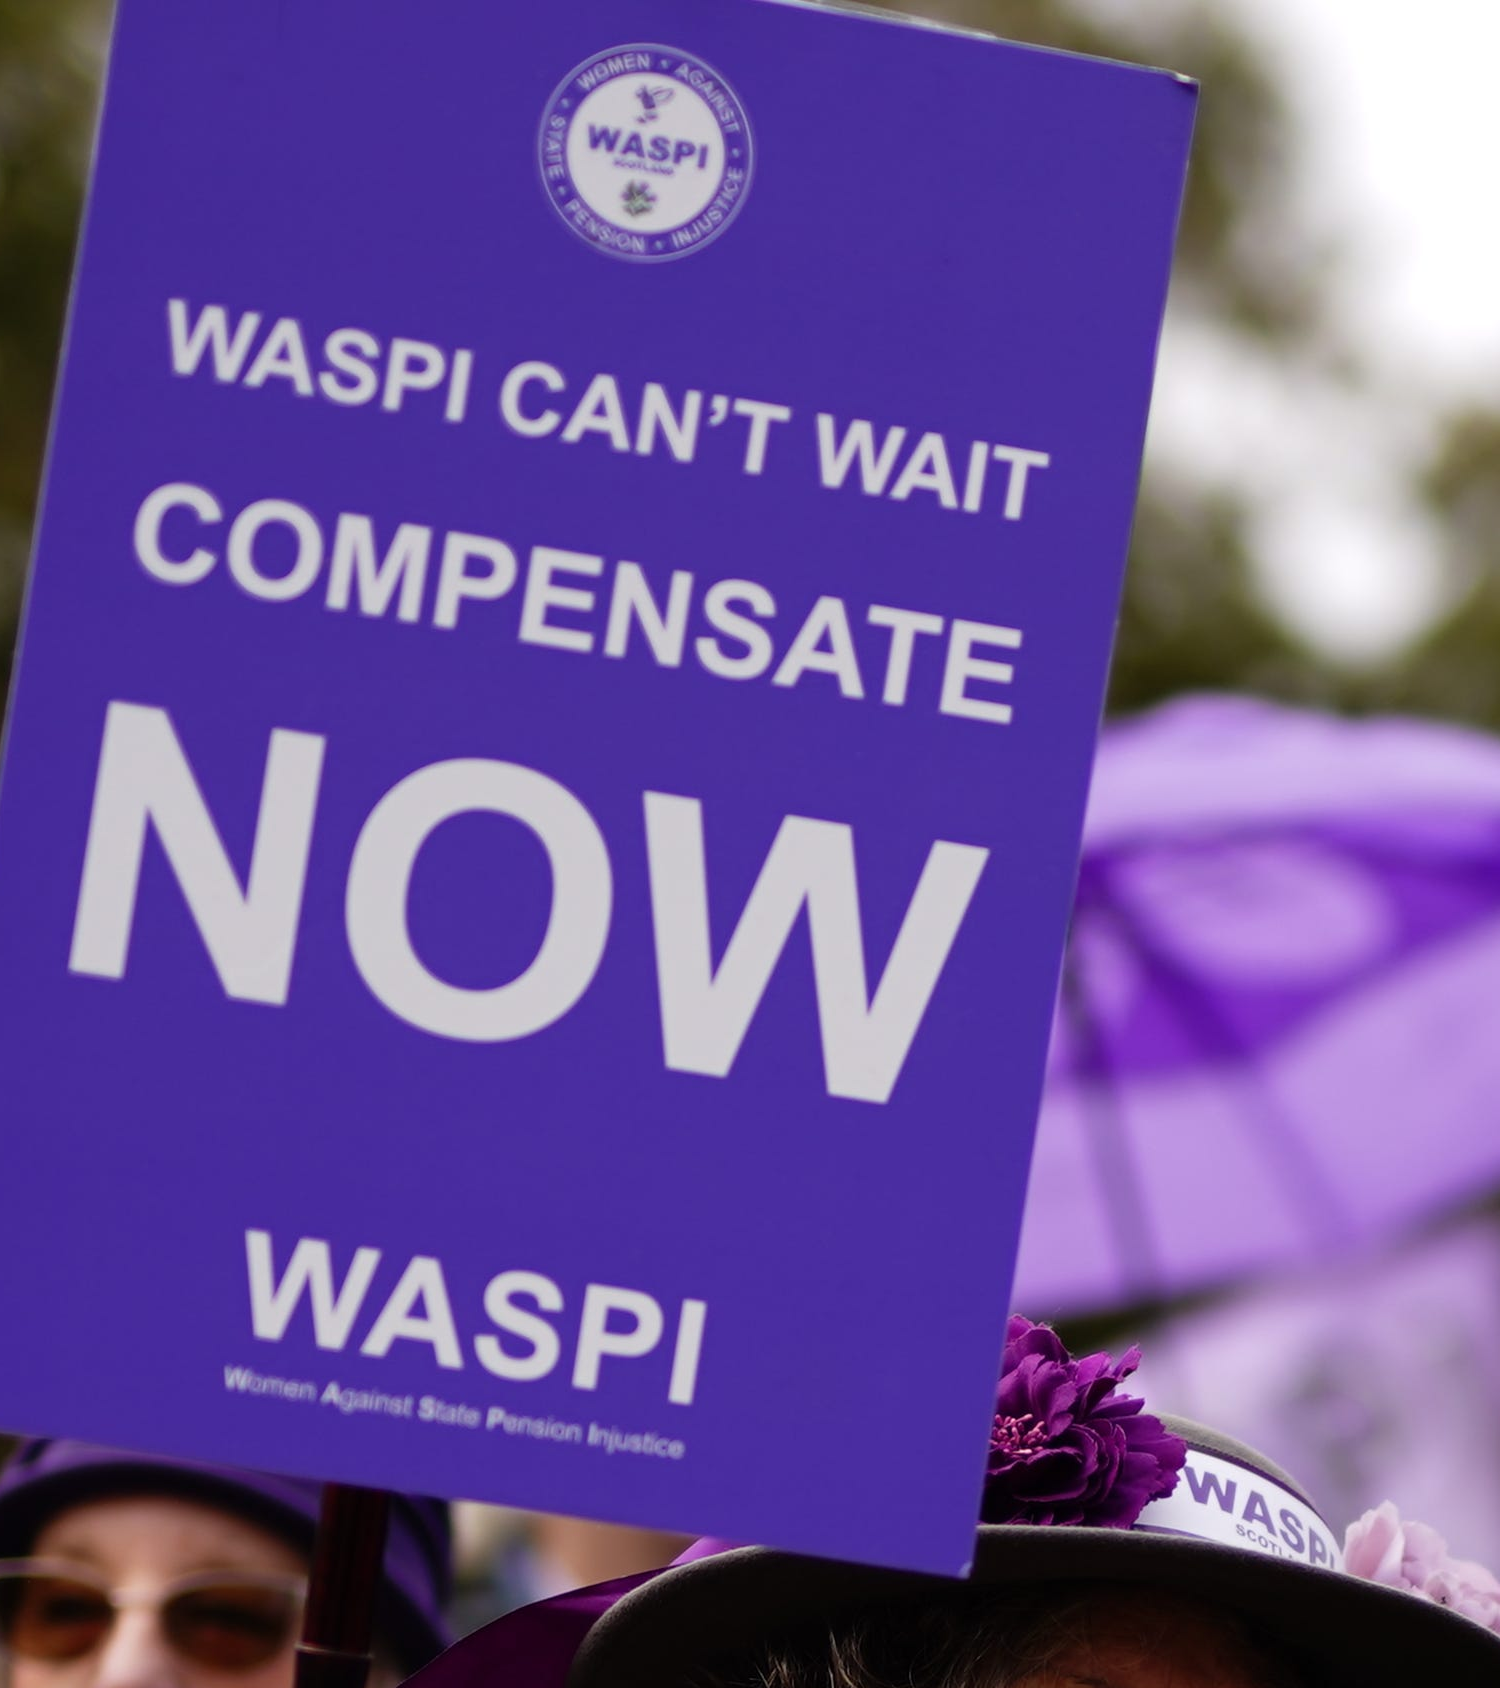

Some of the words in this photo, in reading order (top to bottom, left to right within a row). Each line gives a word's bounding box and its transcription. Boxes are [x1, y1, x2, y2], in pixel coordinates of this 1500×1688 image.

[575, 53, 650, 90] WOMEN
[674, 63, 740, 132] AGAINST
[546, 114, 565, 180] STATE
[587, 123, 709, 170] WASPI
[564, 198, 645, 252] PENSION
[671, 167, 743, 249] INJUSTICE
[166, 299, 472, 423] WASPI
[500, 361, 789, 475] CAN'T
[815, 413, 1049, 520] WAIT
[133, 482, 1022, 724] COMPENSATE
[68, 700, 989, 1106] NOW
[243, 1229, 707, 1406] WASPI
[224, 1366, 316, 1401] Women
[320, 1382, 413, 1418] Against
[417, 1397, 481, 1428] State
[486, 1407, 582, 1444] Pension
[587, 1422, 685, 1460] Injustice
